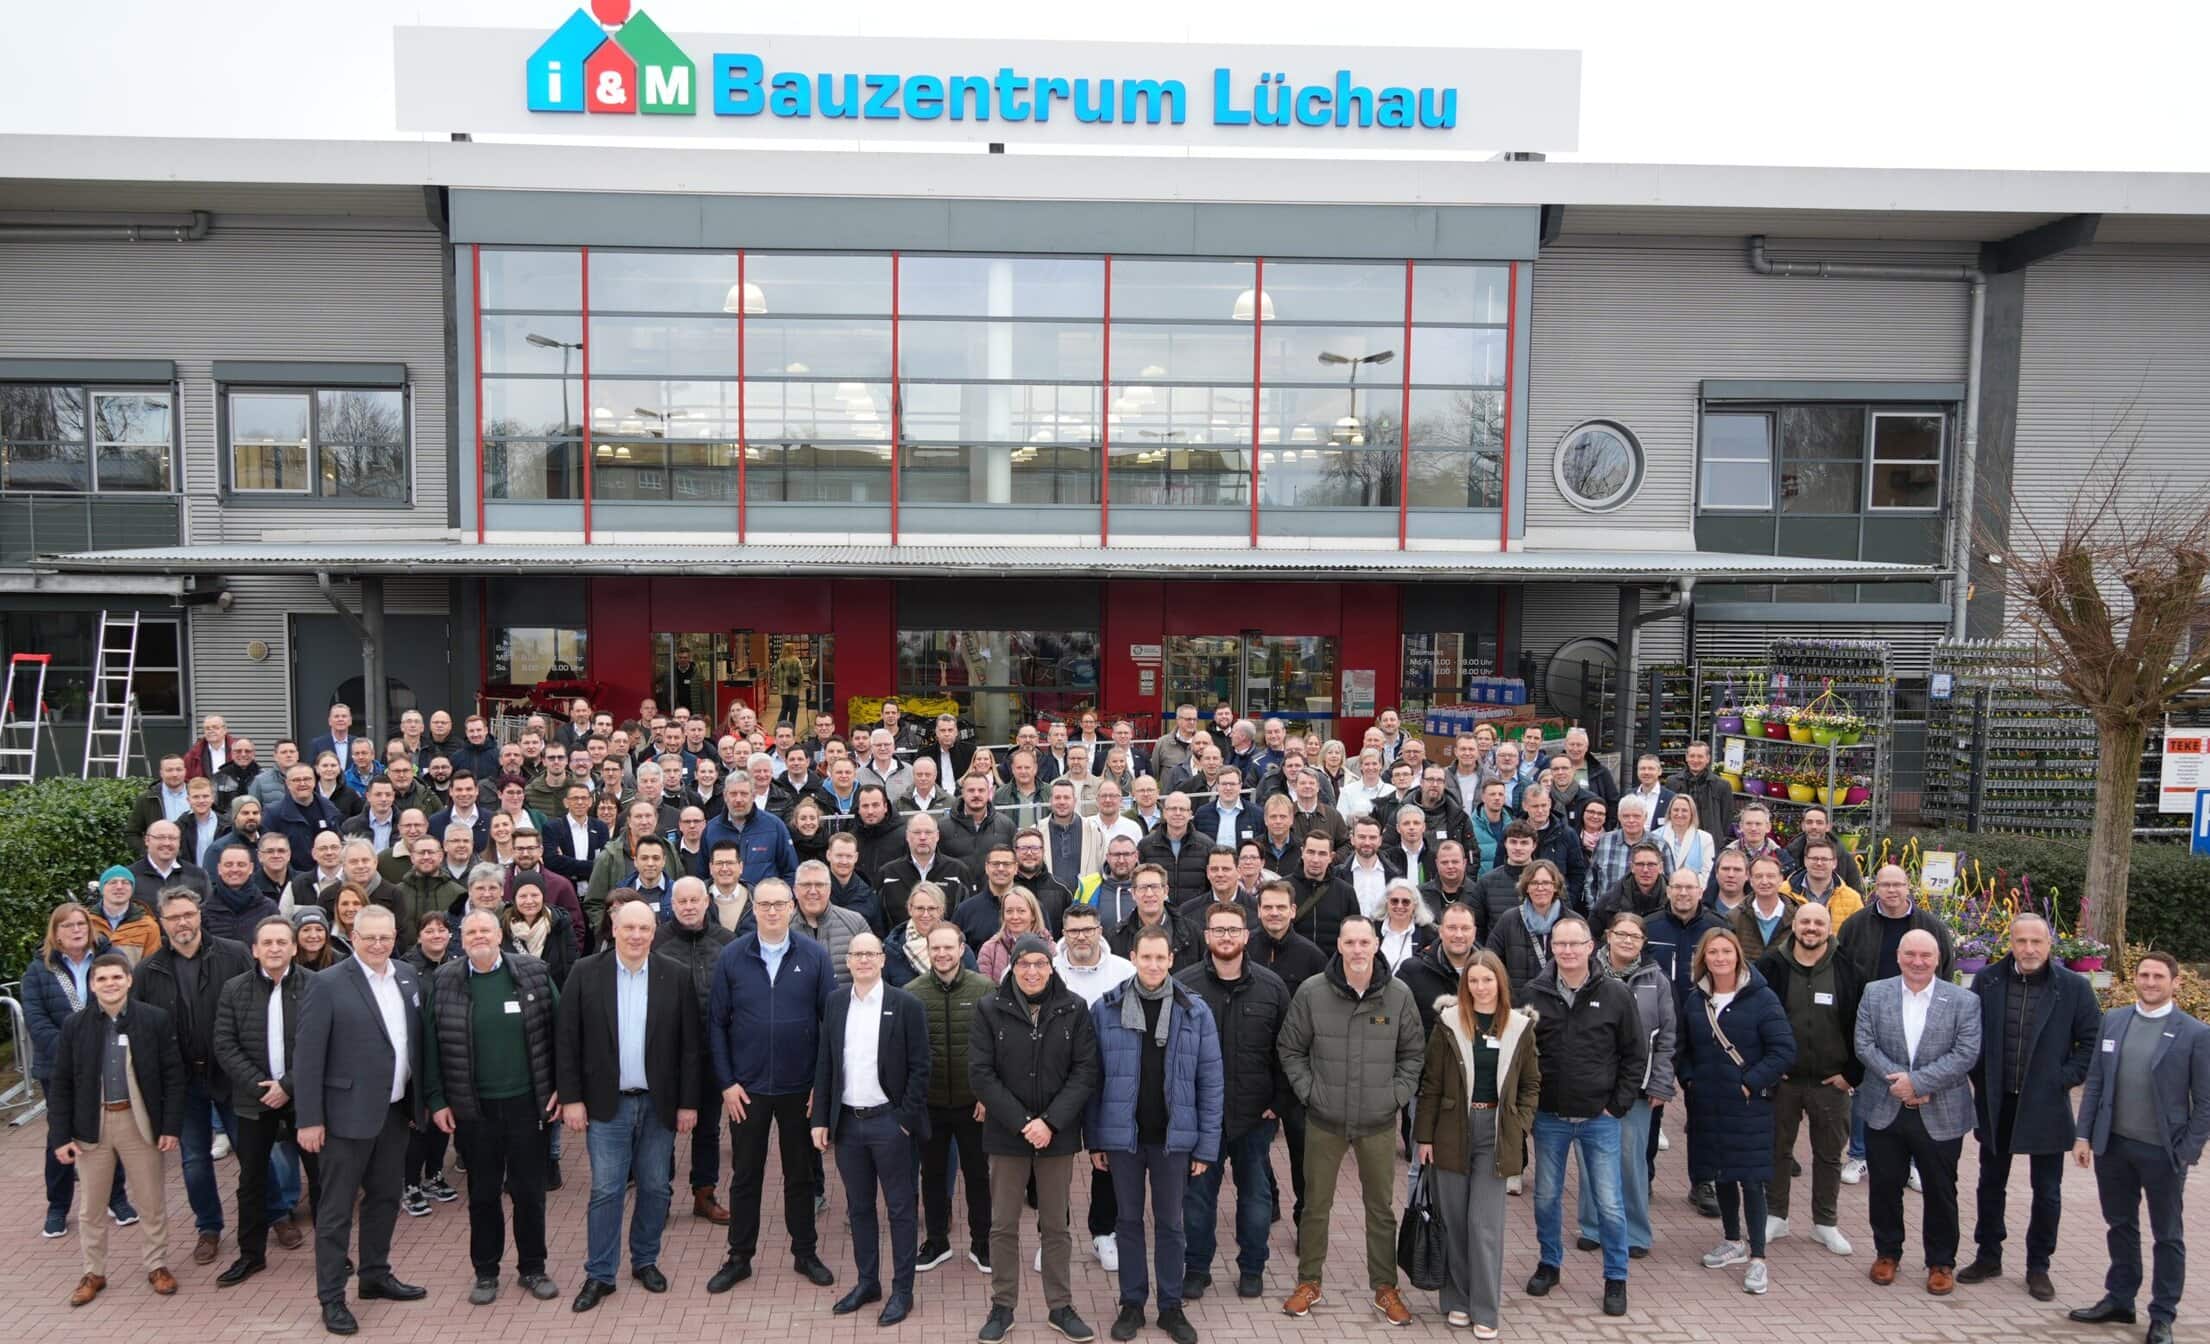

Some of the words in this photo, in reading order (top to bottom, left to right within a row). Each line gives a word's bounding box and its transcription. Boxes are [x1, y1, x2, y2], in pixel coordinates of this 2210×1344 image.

[713, 53, 1186, 124] Bauzentrum
[1213, 67, 1457, 129] Lüchau
[2170, 740, 2200, 752] TEKE
